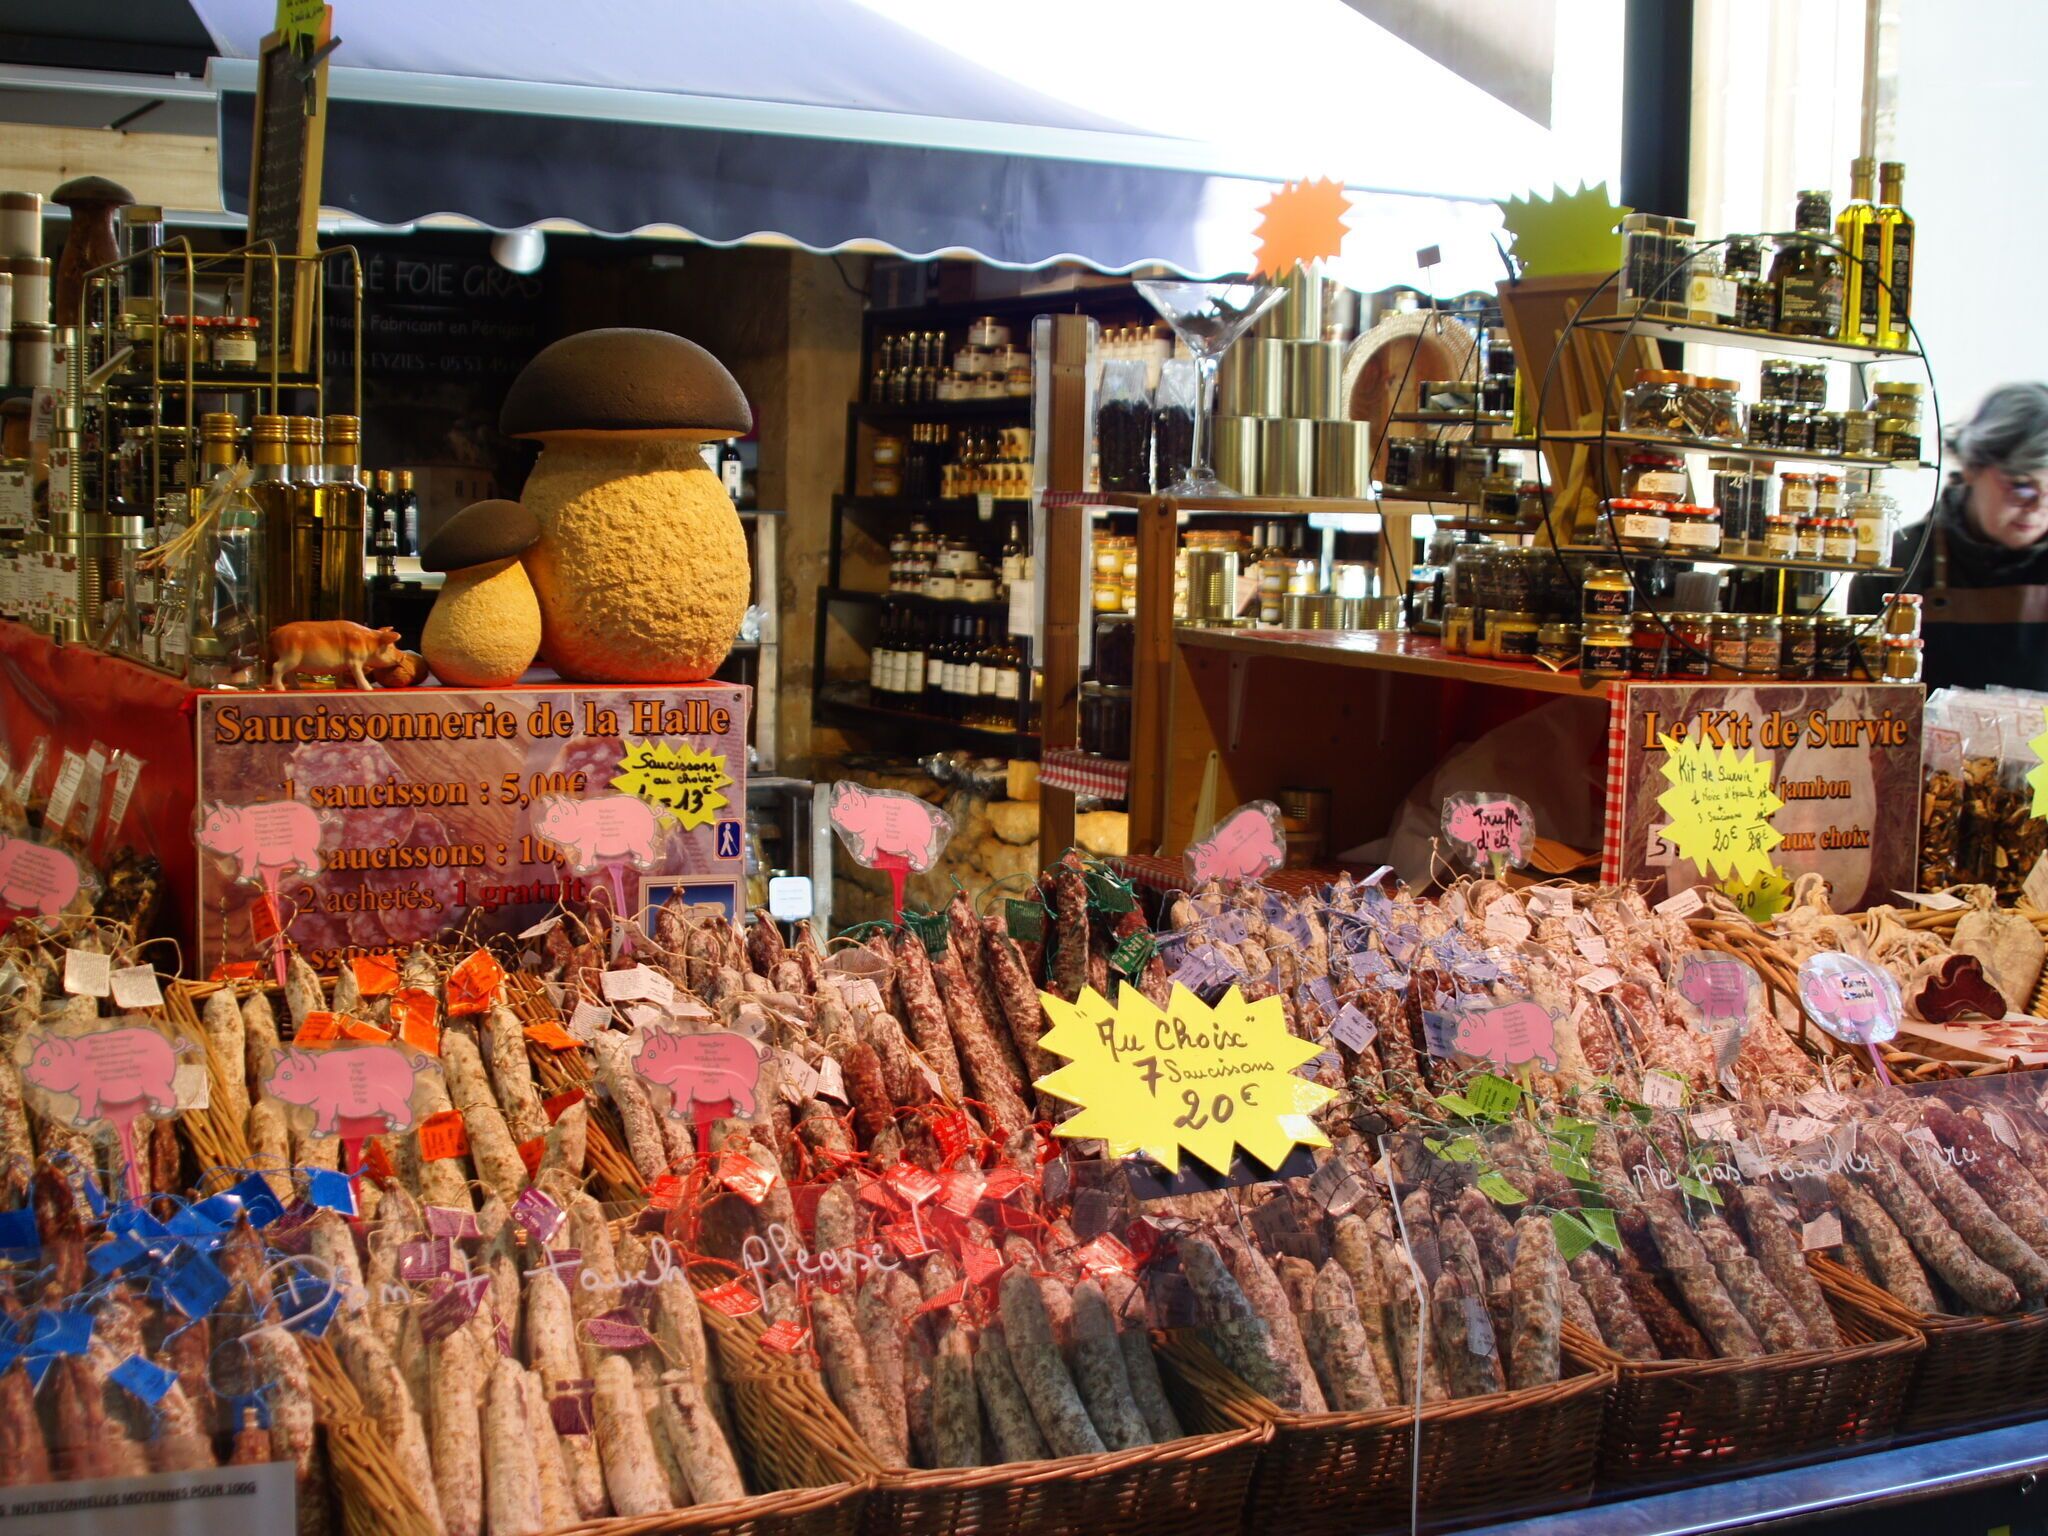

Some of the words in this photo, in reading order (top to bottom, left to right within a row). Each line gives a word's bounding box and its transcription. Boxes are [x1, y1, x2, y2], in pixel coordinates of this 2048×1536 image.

[394, 260, 453, 296] FOIE
[463, 264, 545, 298] GRAS
[215, 703, 518, 743] Saucissonnerie
[527, 702, 574, 738] de
[584, 701, 619, 738] la
[628, 699, 731, 737] Halle
[1642, 711, 1689, 750] Le
[1696, 710, 1752, 750] Kit
[1760, 711, 1801, 749] de
[1807, 709, 1909, 748] Survie
[632, 752, 717, 773] Saucissons
[309, 775, 467, 810] saucisson
[1780, 774, 1852, 803] jambon
[1473, 807, 1522, 832] Truffe
[1712, 825, 1739, 852] 20€
[1780, 829, 1816, 852] aux
[1819, 823, 1871, 850] choix
[299, 886, 316, 914] 2
[326, 880, 444, 914] achetés,
[475, 875, 588, 909] gratuit
[1132, 1055, 1165, 1099] 7
[1163, 1057, 1276, 1084] Saucissons
[1172, 1082, 1261, 1131] 20€
[1632, 1145, 1681, 1193] Ne
[1695, 1162, 1744, 1216] pas
[741, 1217, 903, 1314] Please
[121, 1487, 189, 1505] MOYENNES
[191, 1484, 224, 1500] POUR
